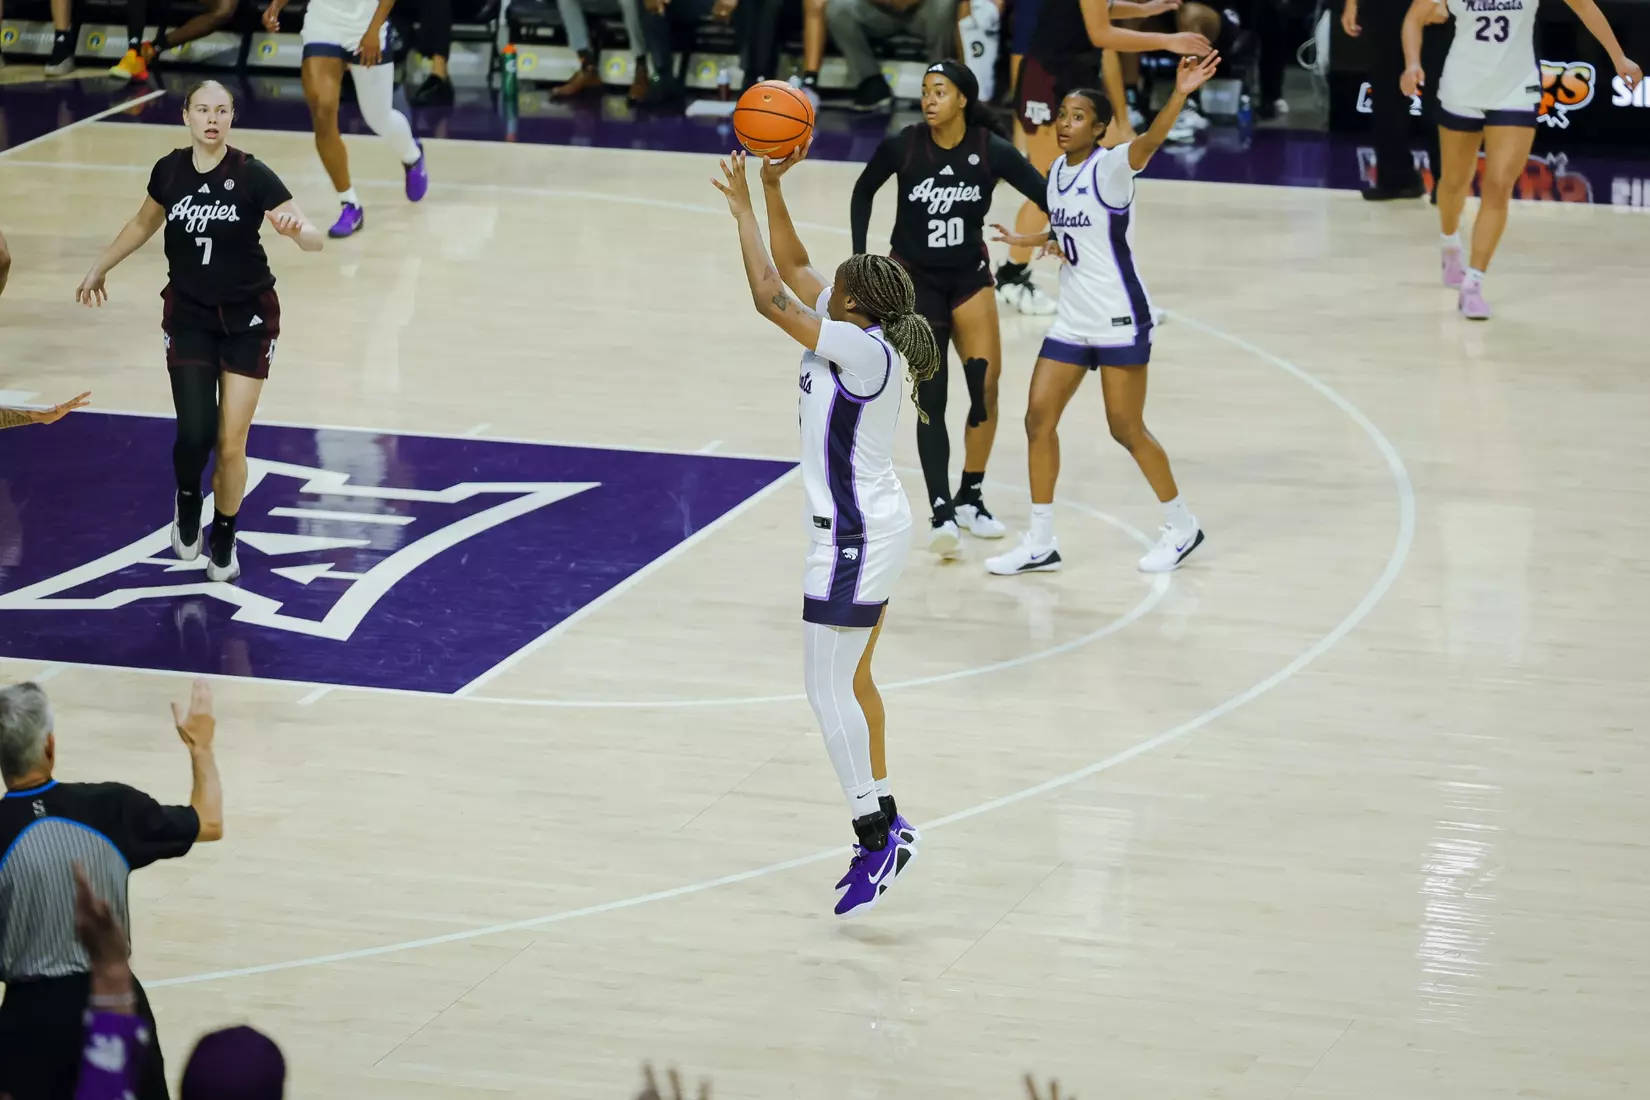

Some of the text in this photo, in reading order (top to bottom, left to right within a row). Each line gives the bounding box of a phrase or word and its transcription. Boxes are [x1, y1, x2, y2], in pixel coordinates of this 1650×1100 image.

[1475, 15, 1509, 43] 23
[908, 177, 982, 215] Aggies
[168, 195, 240, 233] Aggies
[927, 216, 965, 248] 20
[194, 237, 213, 266] 7
